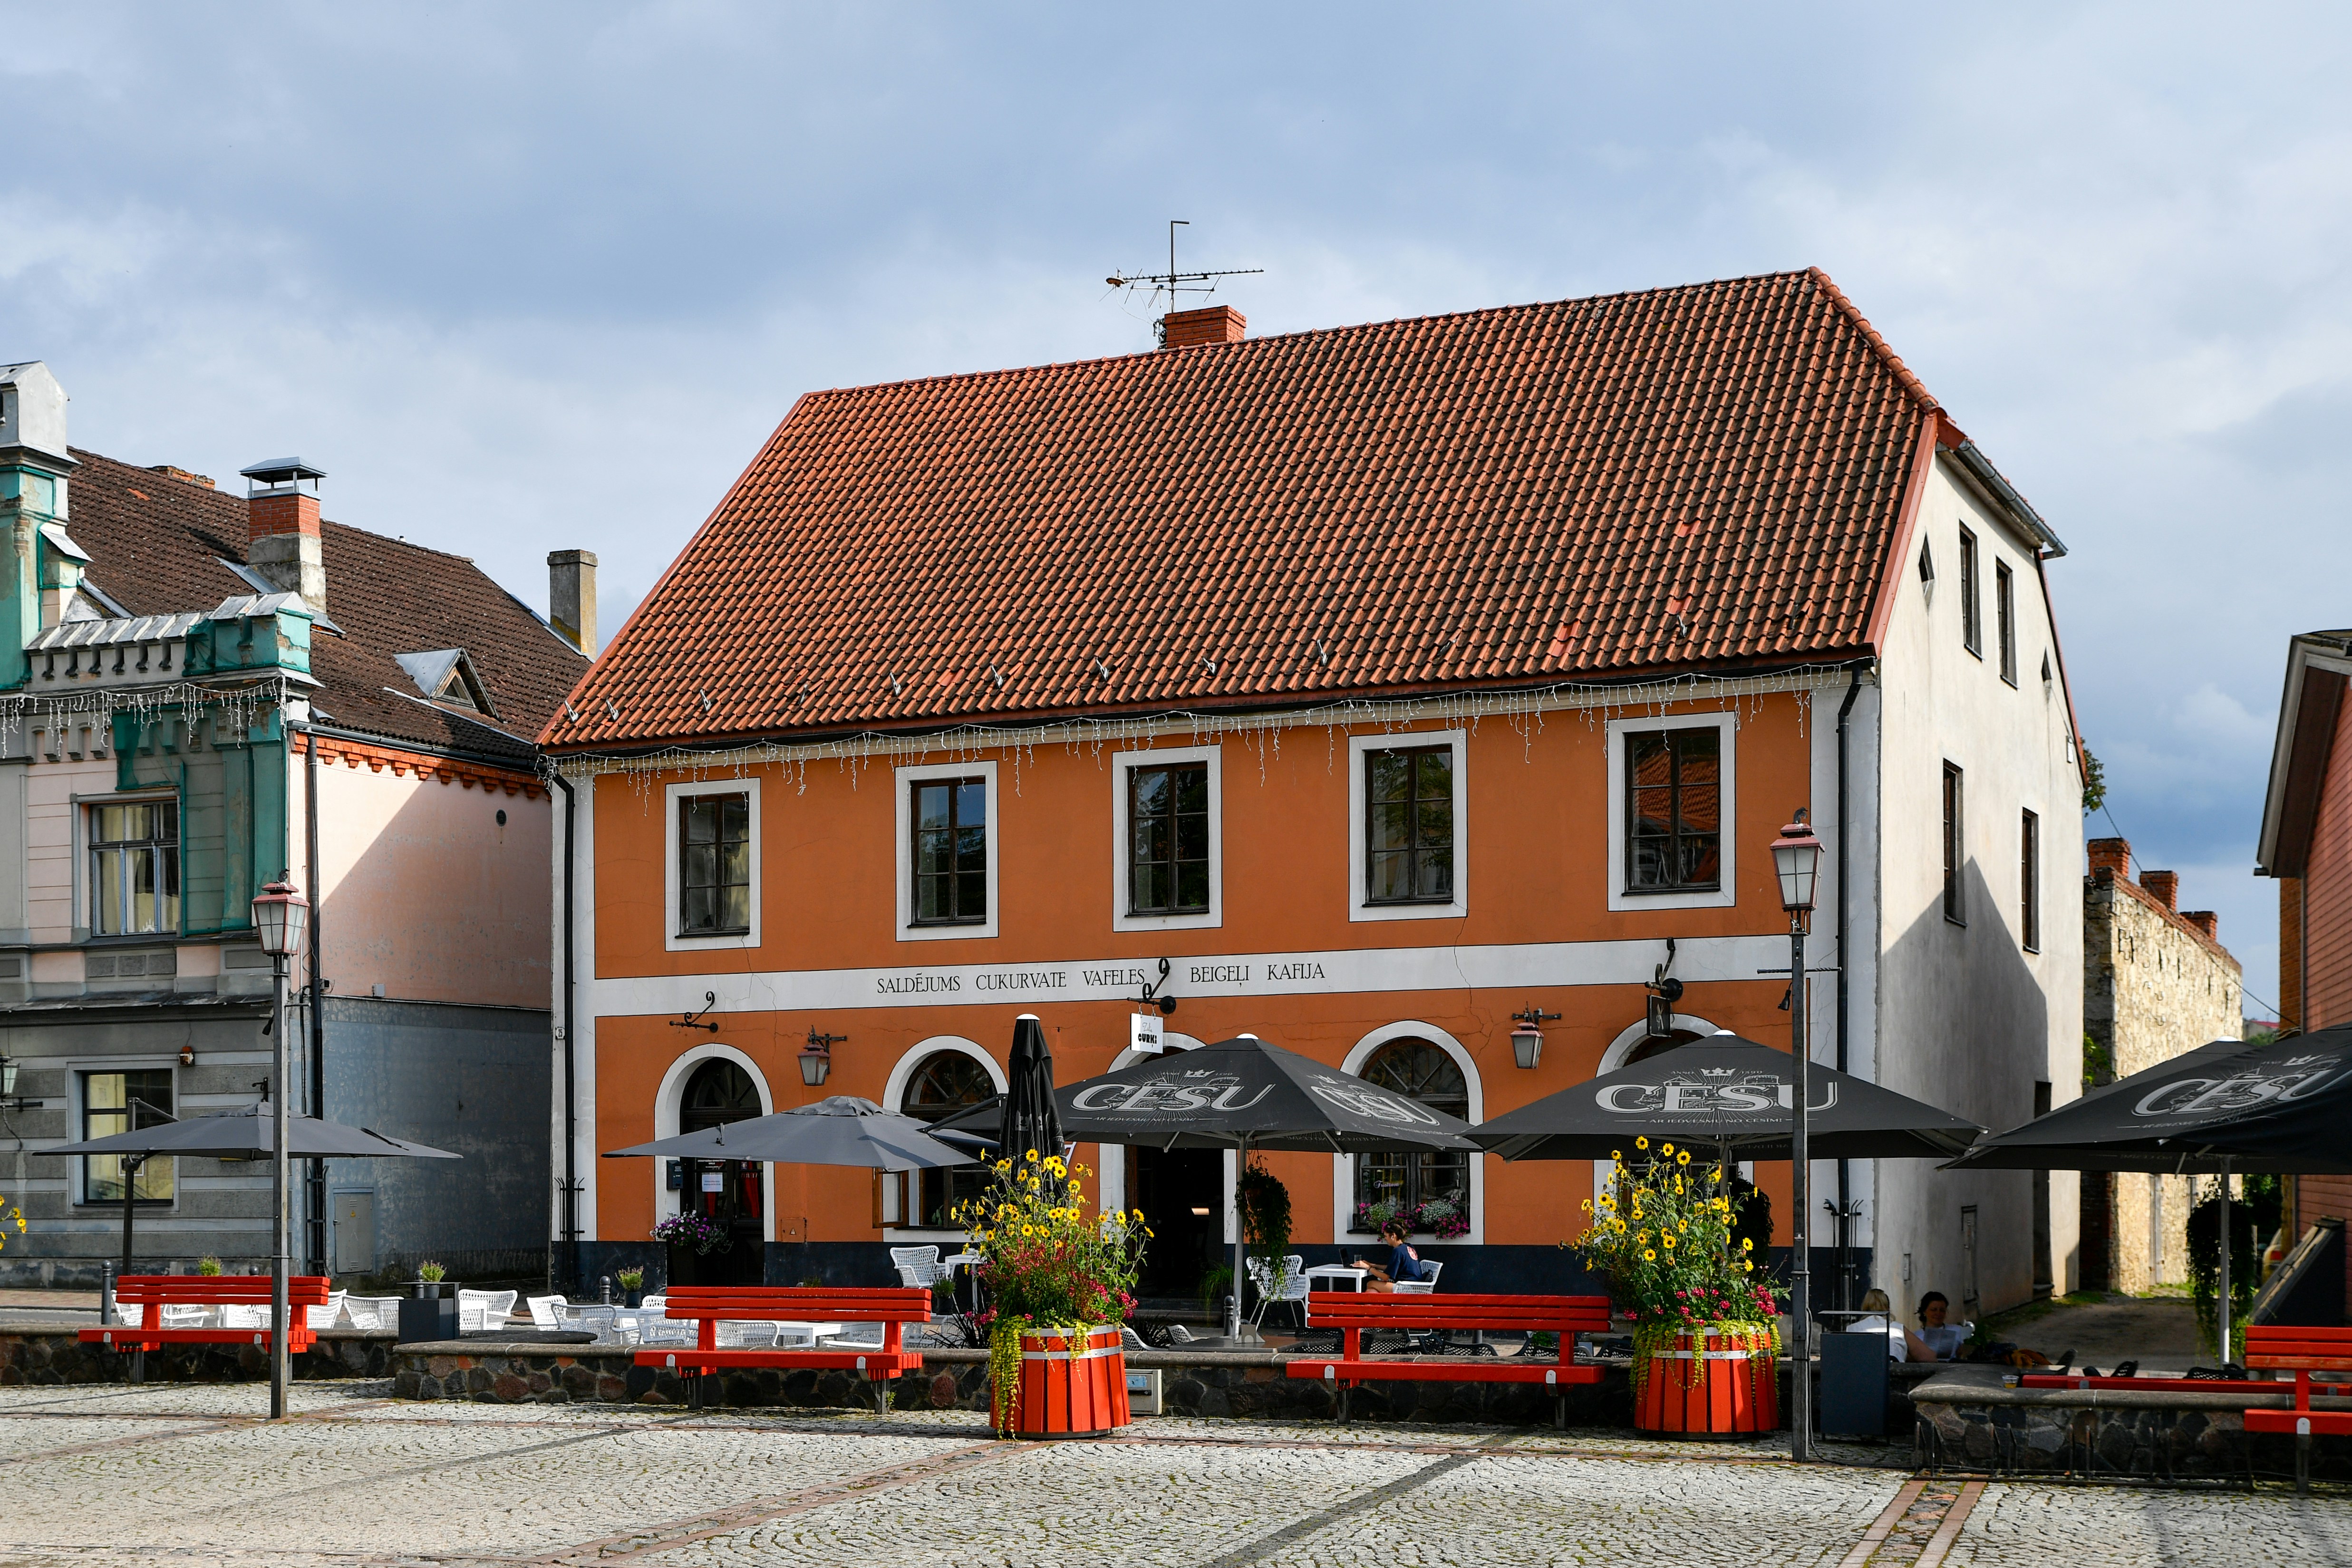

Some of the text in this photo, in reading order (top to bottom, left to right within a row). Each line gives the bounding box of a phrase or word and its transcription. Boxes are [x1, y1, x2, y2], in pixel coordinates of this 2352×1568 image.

[877, 963, 1326, 993] SALDĒJUMS CUKURVATE VAFELES BEIGEĻI KAFIJA
